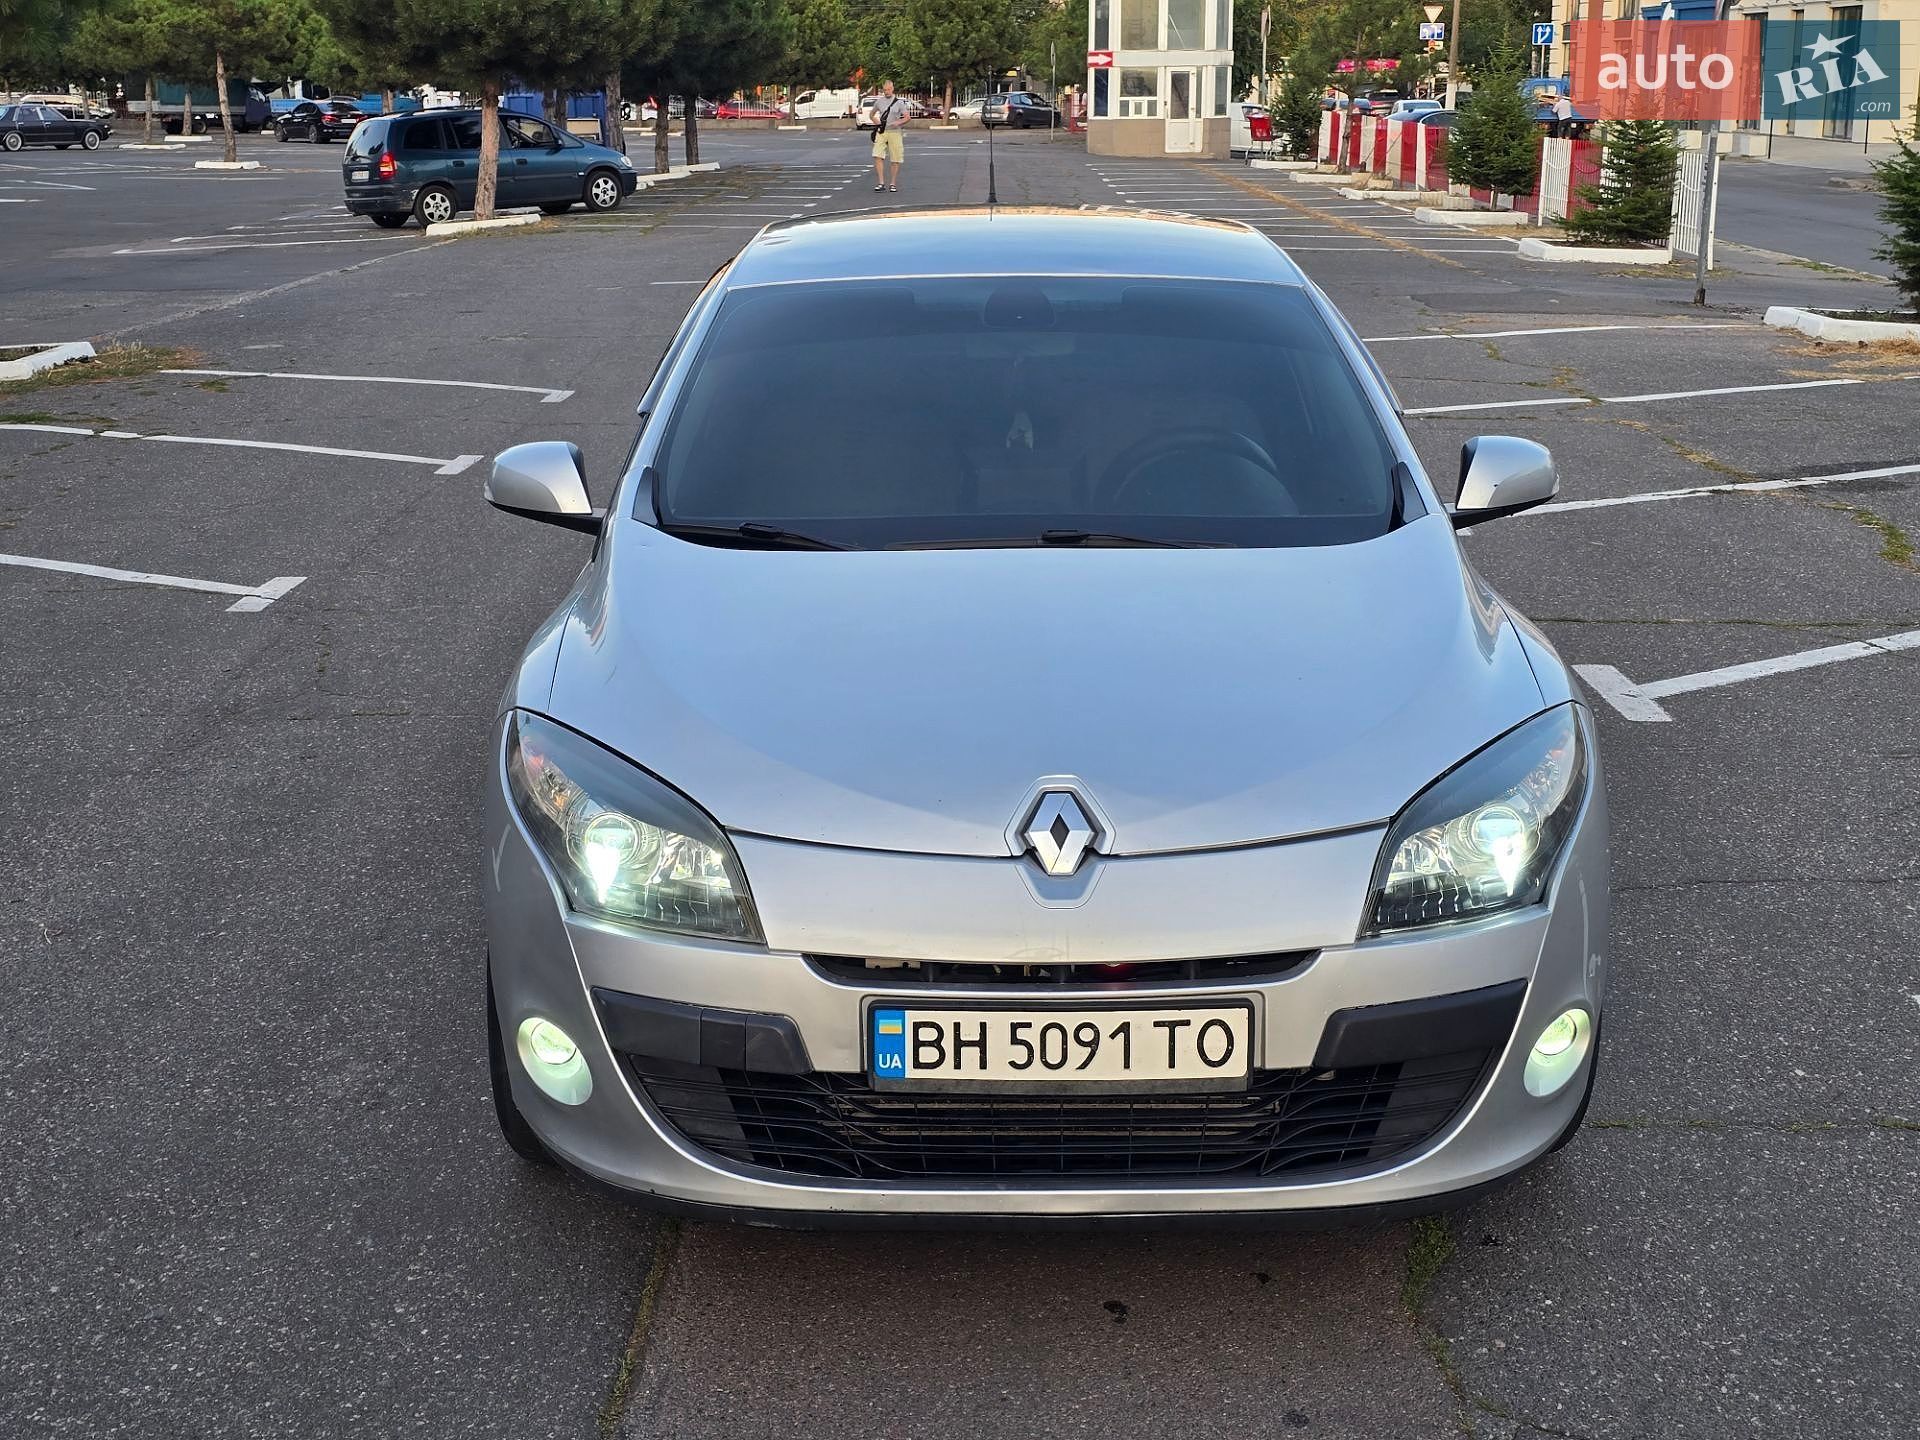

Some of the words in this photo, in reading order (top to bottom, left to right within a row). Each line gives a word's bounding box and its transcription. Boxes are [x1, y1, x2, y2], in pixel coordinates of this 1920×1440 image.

[878, 1053, 903, 1070] UA
[912, 1020, 988, 1071] BH
[1007, 1020, 1132, 1071] 5091
[1152, 1017, 1235, 1069] TO
